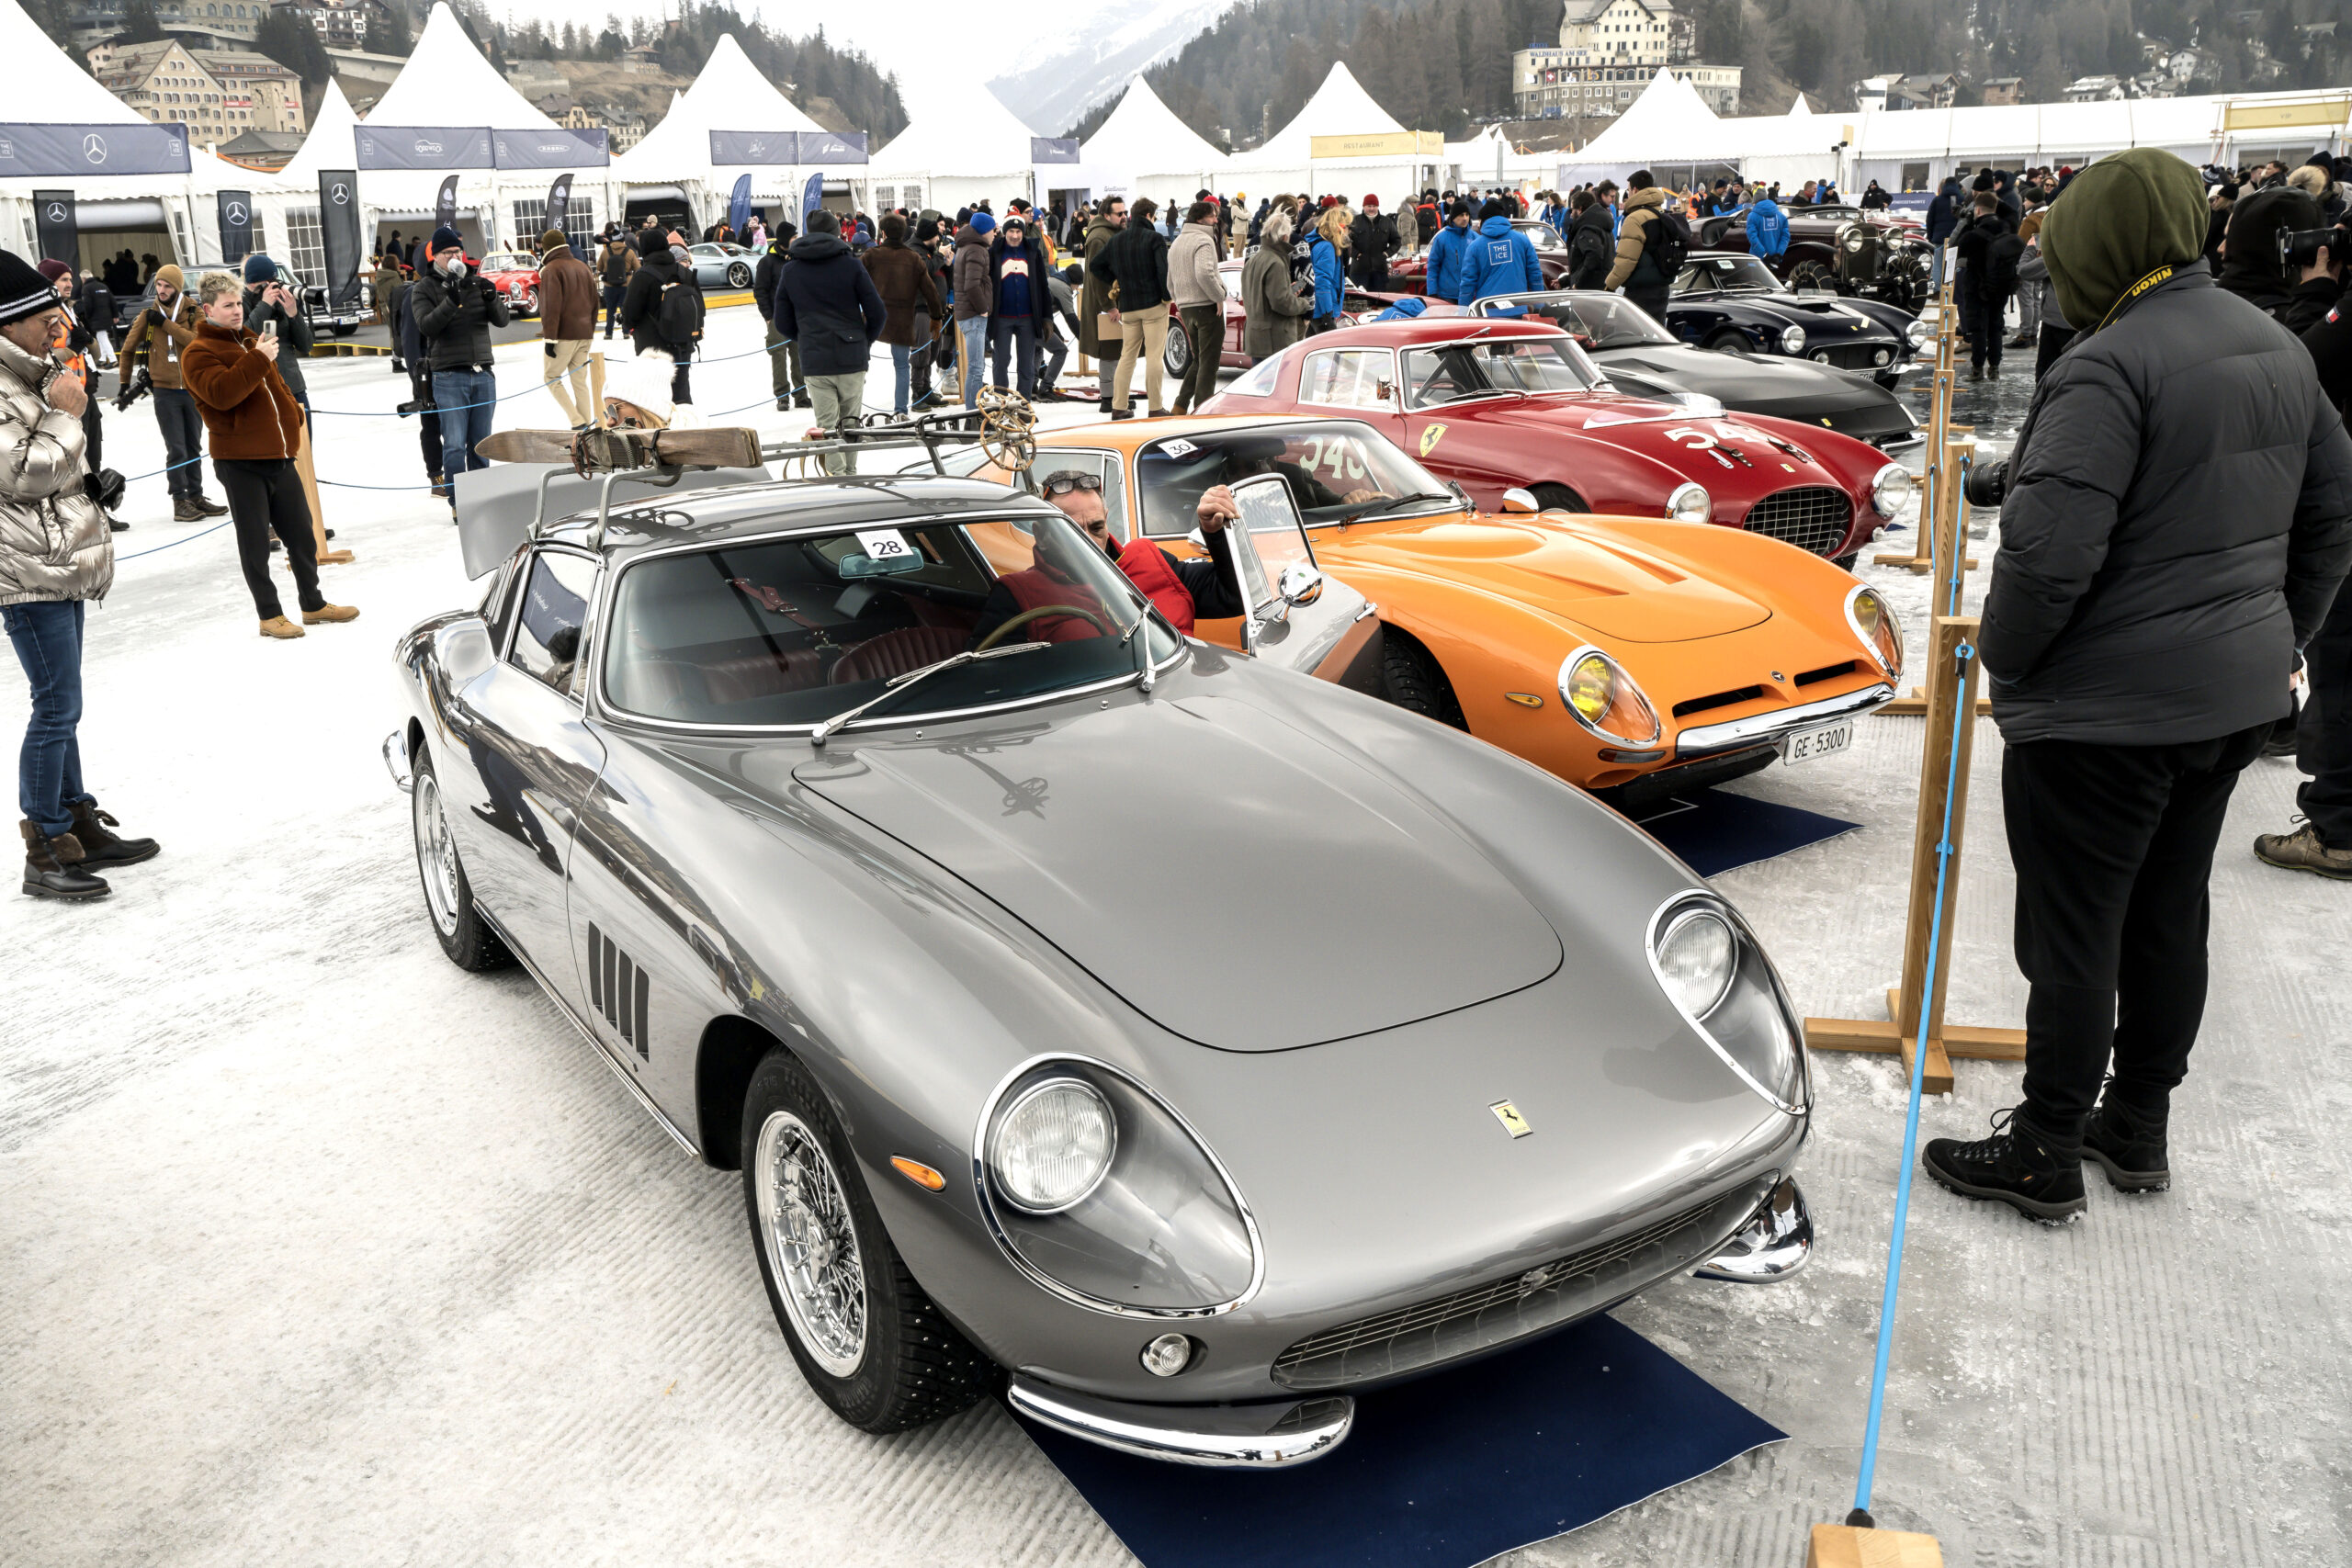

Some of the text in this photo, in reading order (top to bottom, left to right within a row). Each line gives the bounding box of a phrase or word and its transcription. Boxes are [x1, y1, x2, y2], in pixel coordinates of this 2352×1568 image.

[1492, 244, 1508, 253] THE
[2132, 268, 2173, 297] Nikon
[1169, 444, 1191, 455] 30
[872, 540, 903, 556] 28
